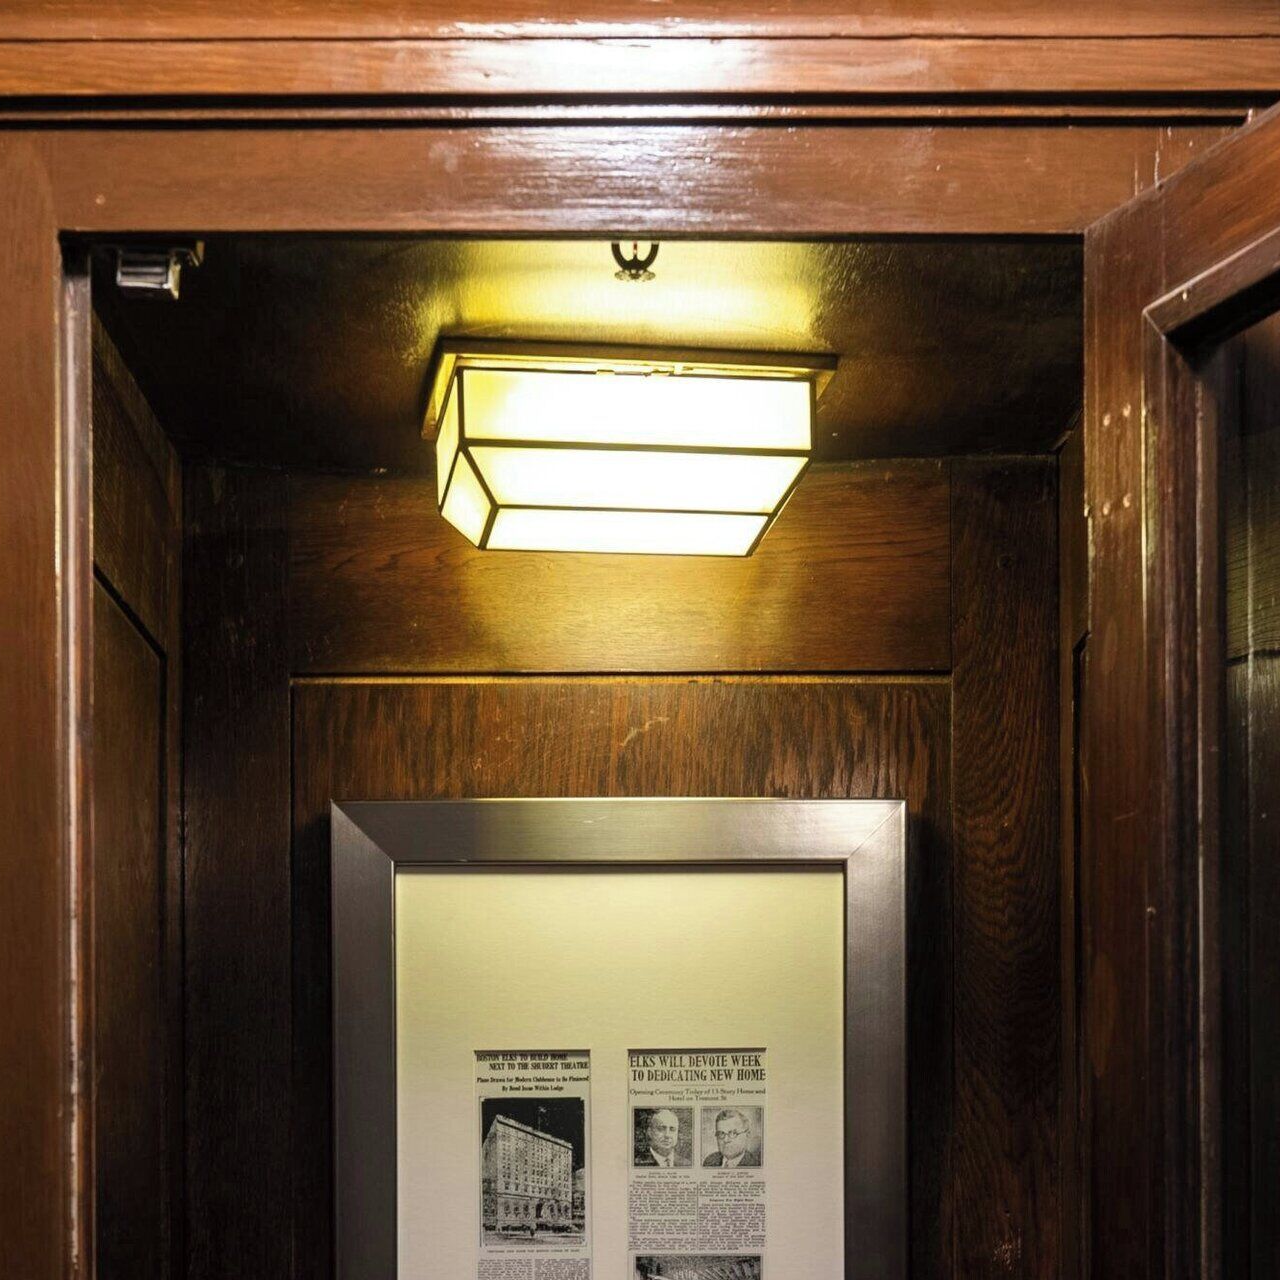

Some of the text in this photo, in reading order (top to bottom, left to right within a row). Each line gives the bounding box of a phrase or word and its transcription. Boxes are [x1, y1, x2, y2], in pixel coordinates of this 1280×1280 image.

[502, 1053, 517, 1061] ELKS
[520, 1053, 529, 1061] TO
[530, 1053, 549, 1061] BUILD
[630, 1054, 761, 1067] ELKS WILL DEVOTE WEEK
[489, 1062, 505, 1070] NEXT
[508, 1062, 515, 1070] TO
[517, 1062, 529, 1070] THE
[560, 1061, 589, 1069] THEATRE
[632, 1068, 766, 1081] TO DEDICATING NEW HOME
